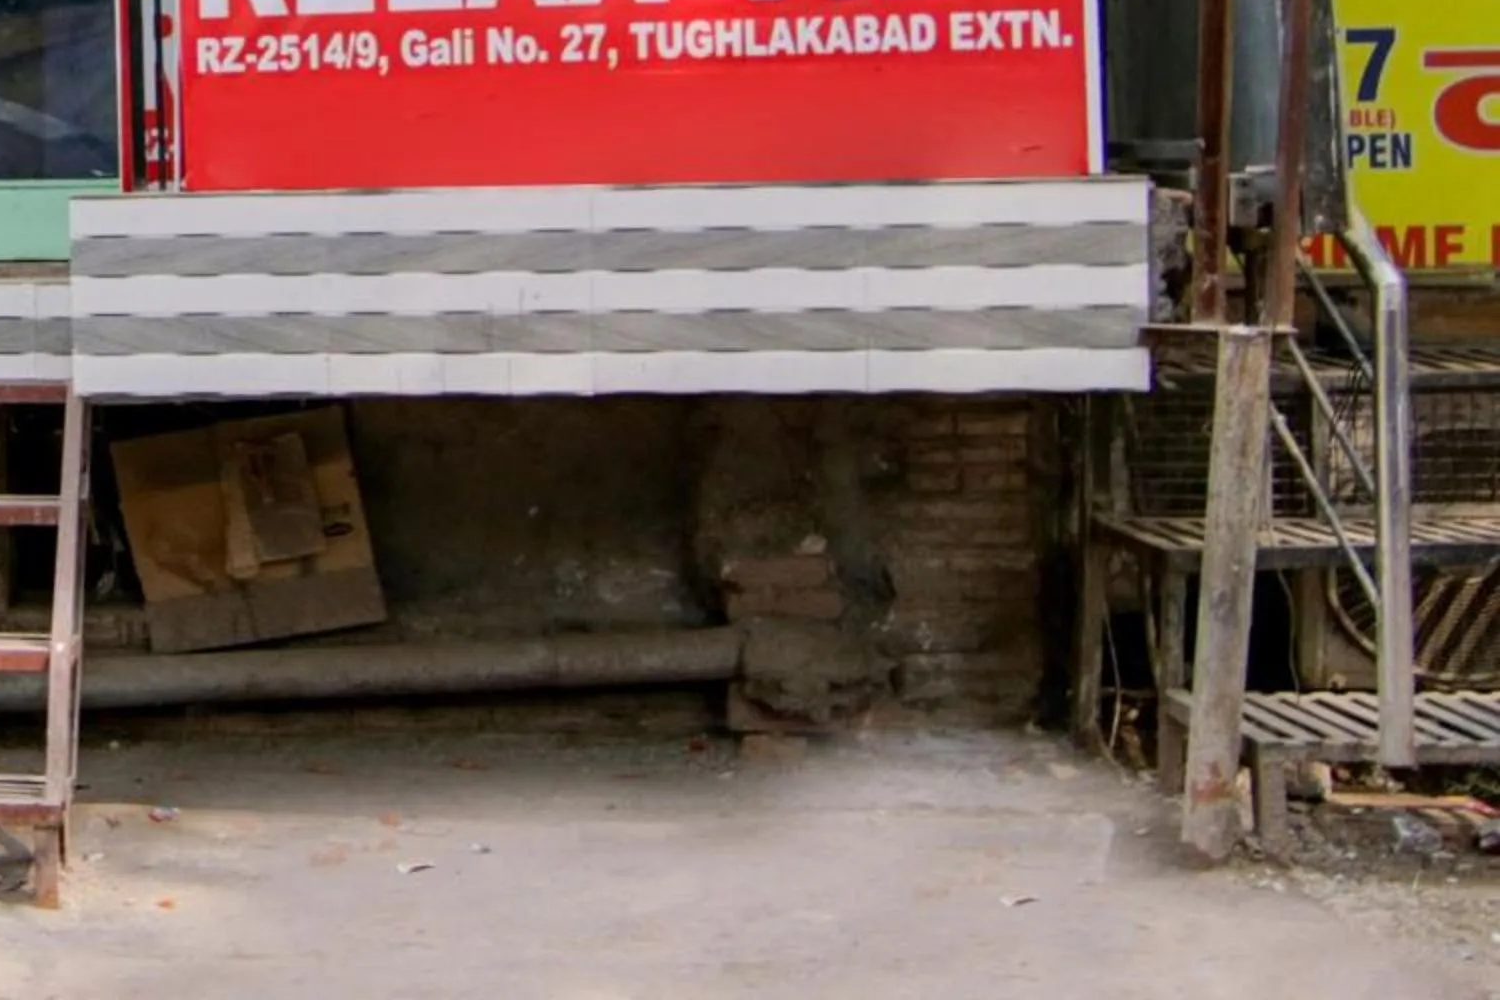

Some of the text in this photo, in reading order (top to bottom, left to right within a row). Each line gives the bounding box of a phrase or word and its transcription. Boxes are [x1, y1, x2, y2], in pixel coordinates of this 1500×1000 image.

[197, 11, 1073, 74] RZ-2514/9, Gali No. 27, TUGHLAKABAD EXTN.
[1347, 132, 1412, 169] PEN
